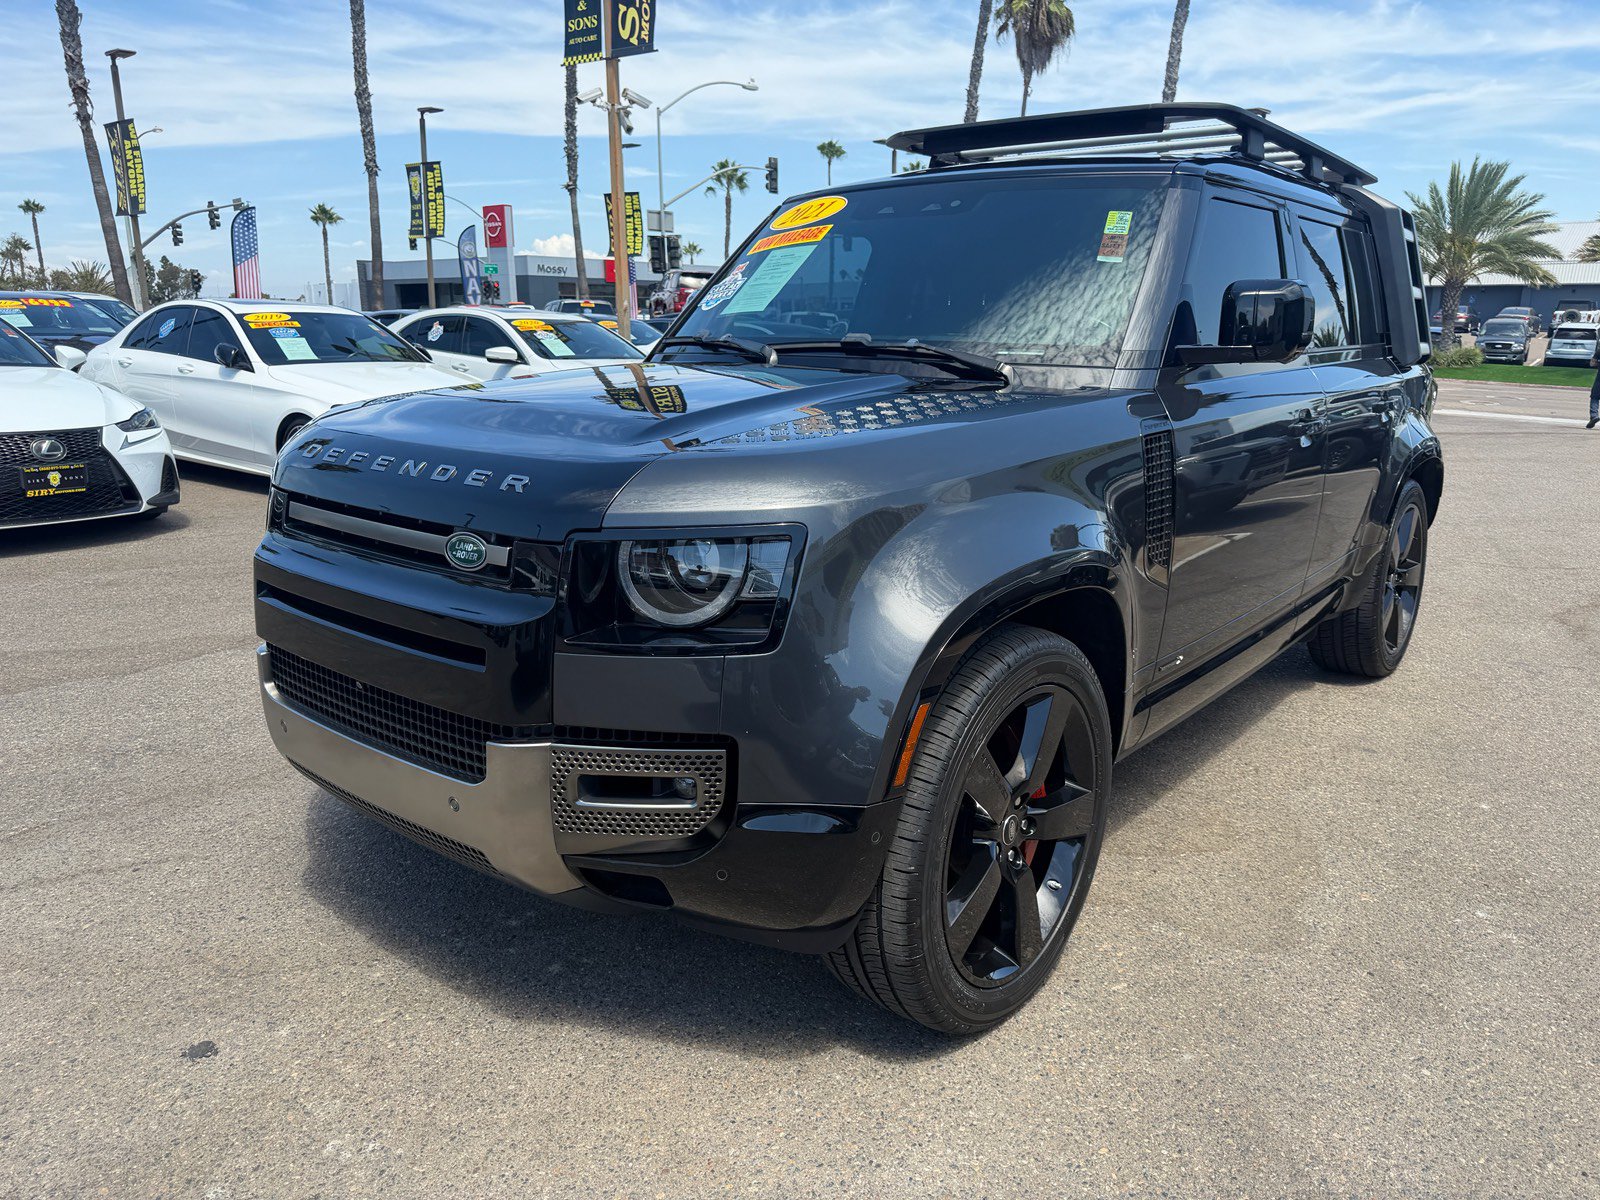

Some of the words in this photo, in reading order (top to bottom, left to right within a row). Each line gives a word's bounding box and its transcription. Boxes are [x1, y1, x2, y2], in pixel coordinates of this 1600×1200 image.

[577, 0, 587, 11] &
[568, 15, 598, 32] SONS
[618, 0, 639, 46] S
[641, 0, 651, 43] MO
[569, 37, 583, 45] AUTO
[583, 34, 598, 42] CARE
[124, 140, 137, 196] ANYONE
[128, 123, 138, 147] WE
[133, 150, 145, 211] FINANCE
[433, 164, 442, 188] FULL
[427, 172, 435, 200] AUTO
[625, 195, 633, 216] OUR
[632, 194, 640, 210] WE
[777, 200, 838, 226] 2021
[626, 217, 634, 254] TROOPS
[634, 212, 642, 255] SUPPORT
[753, 237, 776, 251] LOW
[775, 226, 828, 246] MILEAGE
[537, 264, 567, 276] Mossy
[301, 443, 531, 493] DEFENDER
[455, 542, 473, 551] LAND
[456, 550, 478, 560] ROVER
